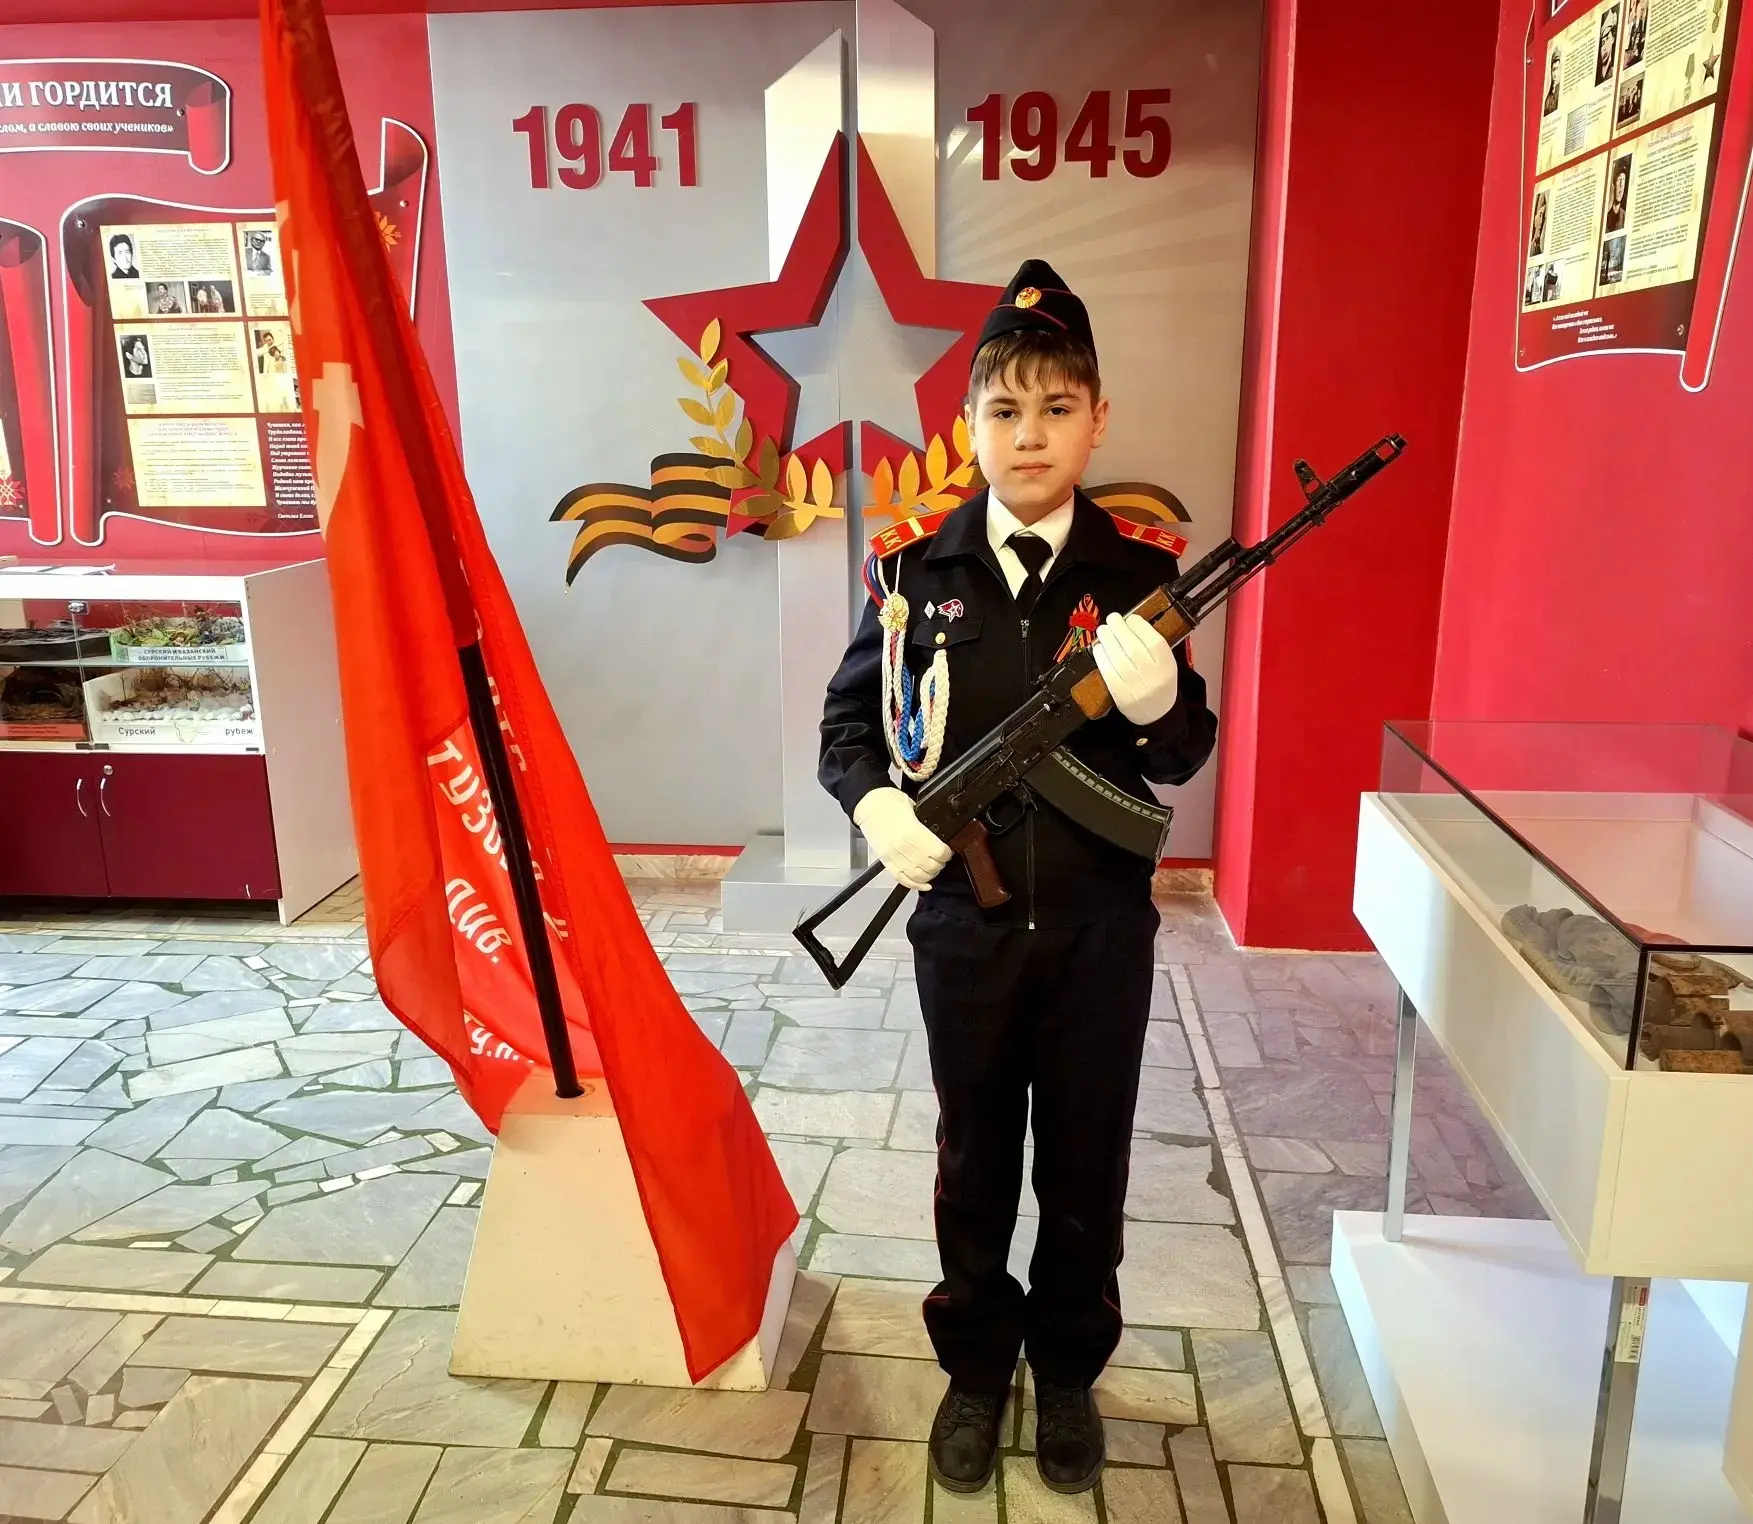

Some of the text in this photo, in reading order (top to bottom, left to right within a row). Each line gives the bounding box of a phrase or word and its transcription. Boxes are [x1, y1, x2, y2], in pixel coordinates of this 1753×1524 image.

[0, 80, 173, 111] И ГОРДИТСЯ
[29, 123, 36, 132] а
[38, 122, 80, 132] славою
[81, 122, 113, 132] своих
[113, 122, 174, 134] учеников»
[966, 88, 1172, 181] 1945
[512, 102, 698, 189] 1941
[880, 528, 902, 550] КК
[1156, 531, 1177, 547] КК
[118, 726, 254, 736] Сурский рубеж
